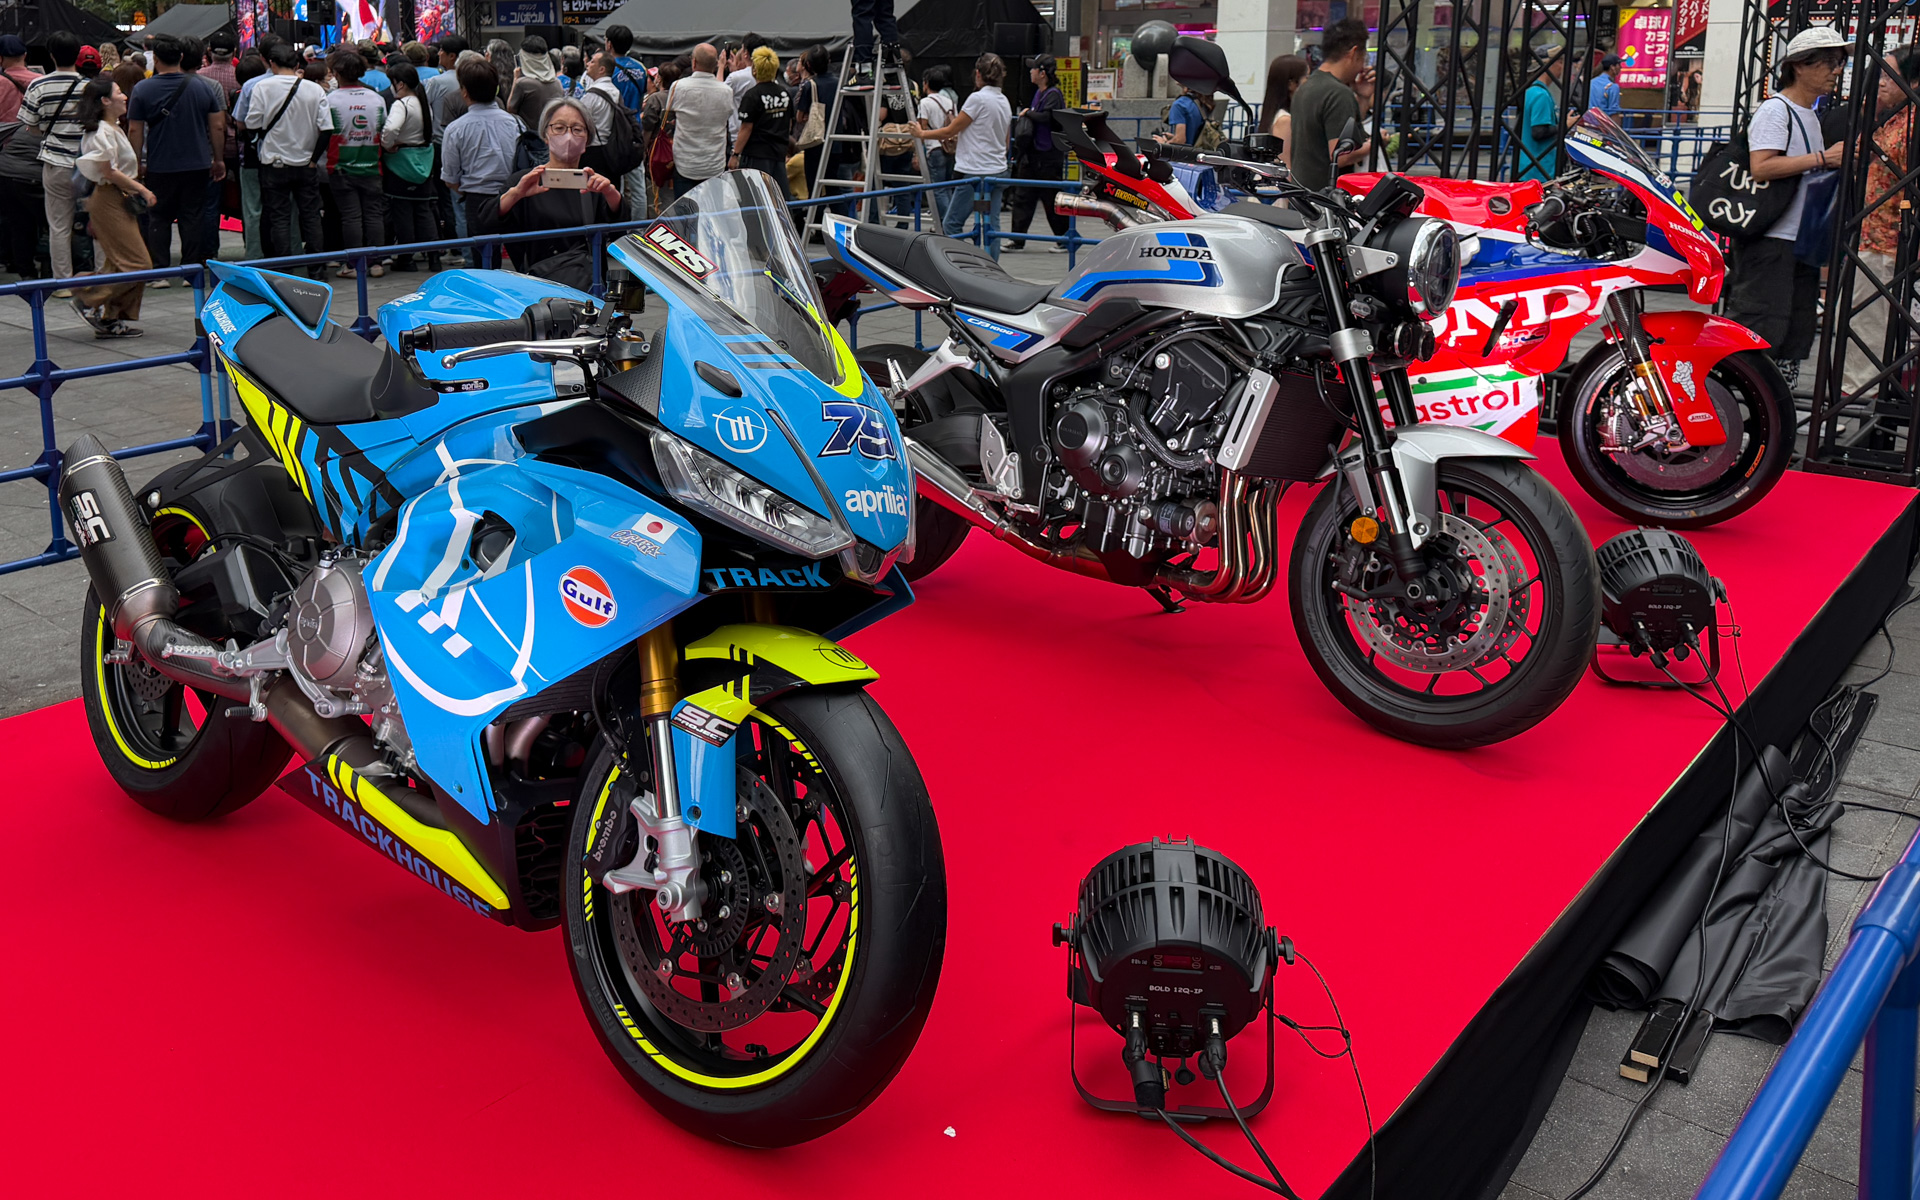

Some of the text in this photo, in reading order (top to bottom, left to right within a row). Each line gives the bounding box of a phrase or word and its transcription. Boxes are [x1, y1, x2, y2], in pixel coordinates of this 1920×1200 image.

[1654, 56, 1668, 67] ダ
[1637, 74, 1658, 85] Ping
[1668, 221, 1707, 244] HONDA
[649, 226, 715, 273] WRS
[1139, 247, 1216, 262] HONDA
[211, 306, 238, 335] TRACKHOUSE
[461, 380, 484, 391] aprilia
[845, 484, 908, 518] aprilia
[81, 491, 111, 542] SC
[703, 562, 832, 590] TRACK
[562, 579, 614, 616] Gulf
[674, 717, 724, 742] PROJECT
[679, 705, 737, 738] SC
[305, 766, 491, 919] TRACKHOUSE
[593, 810, 617, 862] brembo
[1149, 985, 1203, 995] BOLD 12Q-IP
